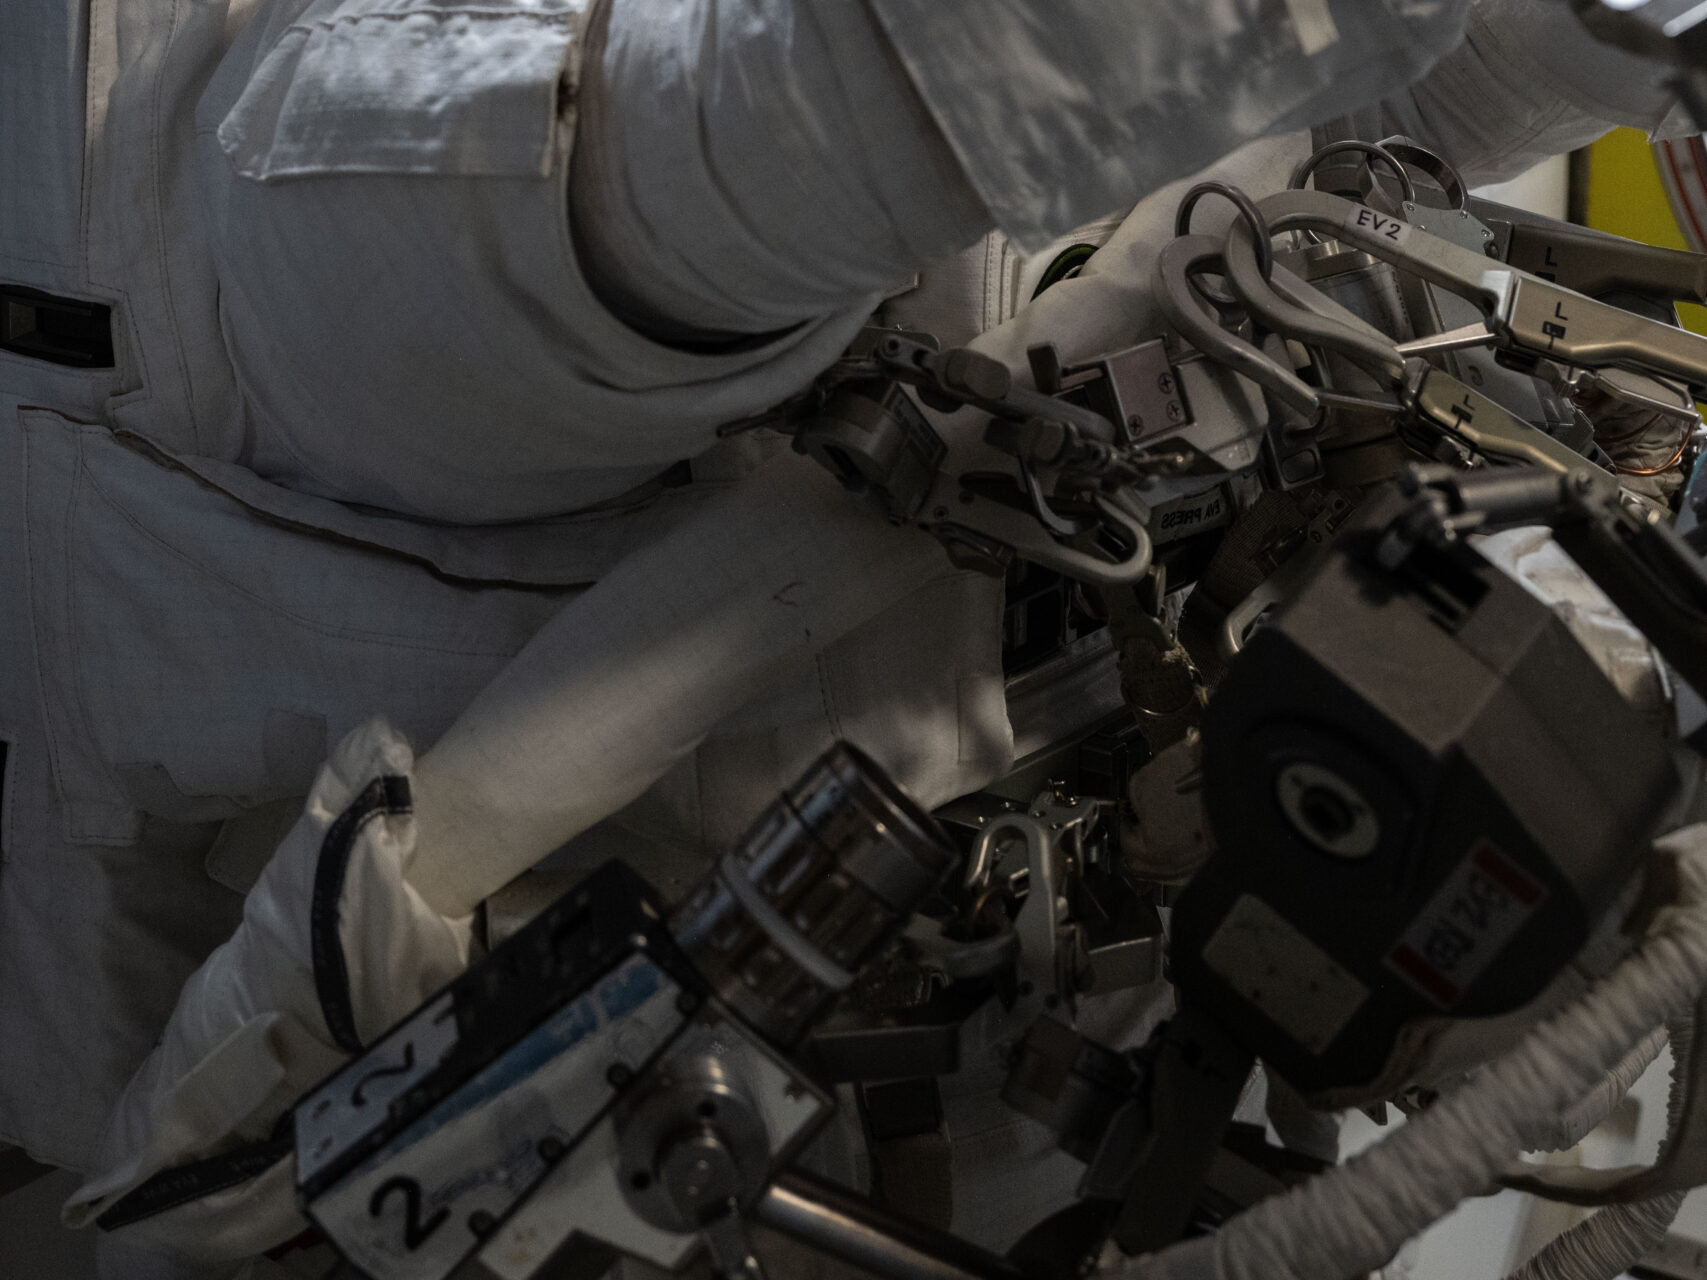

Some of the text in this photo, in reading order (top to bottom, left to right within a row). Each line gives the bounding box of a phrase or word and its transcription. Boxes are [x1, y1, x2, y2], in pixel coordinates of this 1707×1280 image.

[1356, 209, 1403, 241] EV2
[1544, 246, 1558, 268] L
[1555, 301, 1569, 321] L
[1462, 393, 1474, 411] L
[369, 1177, 451, 1252] 2
